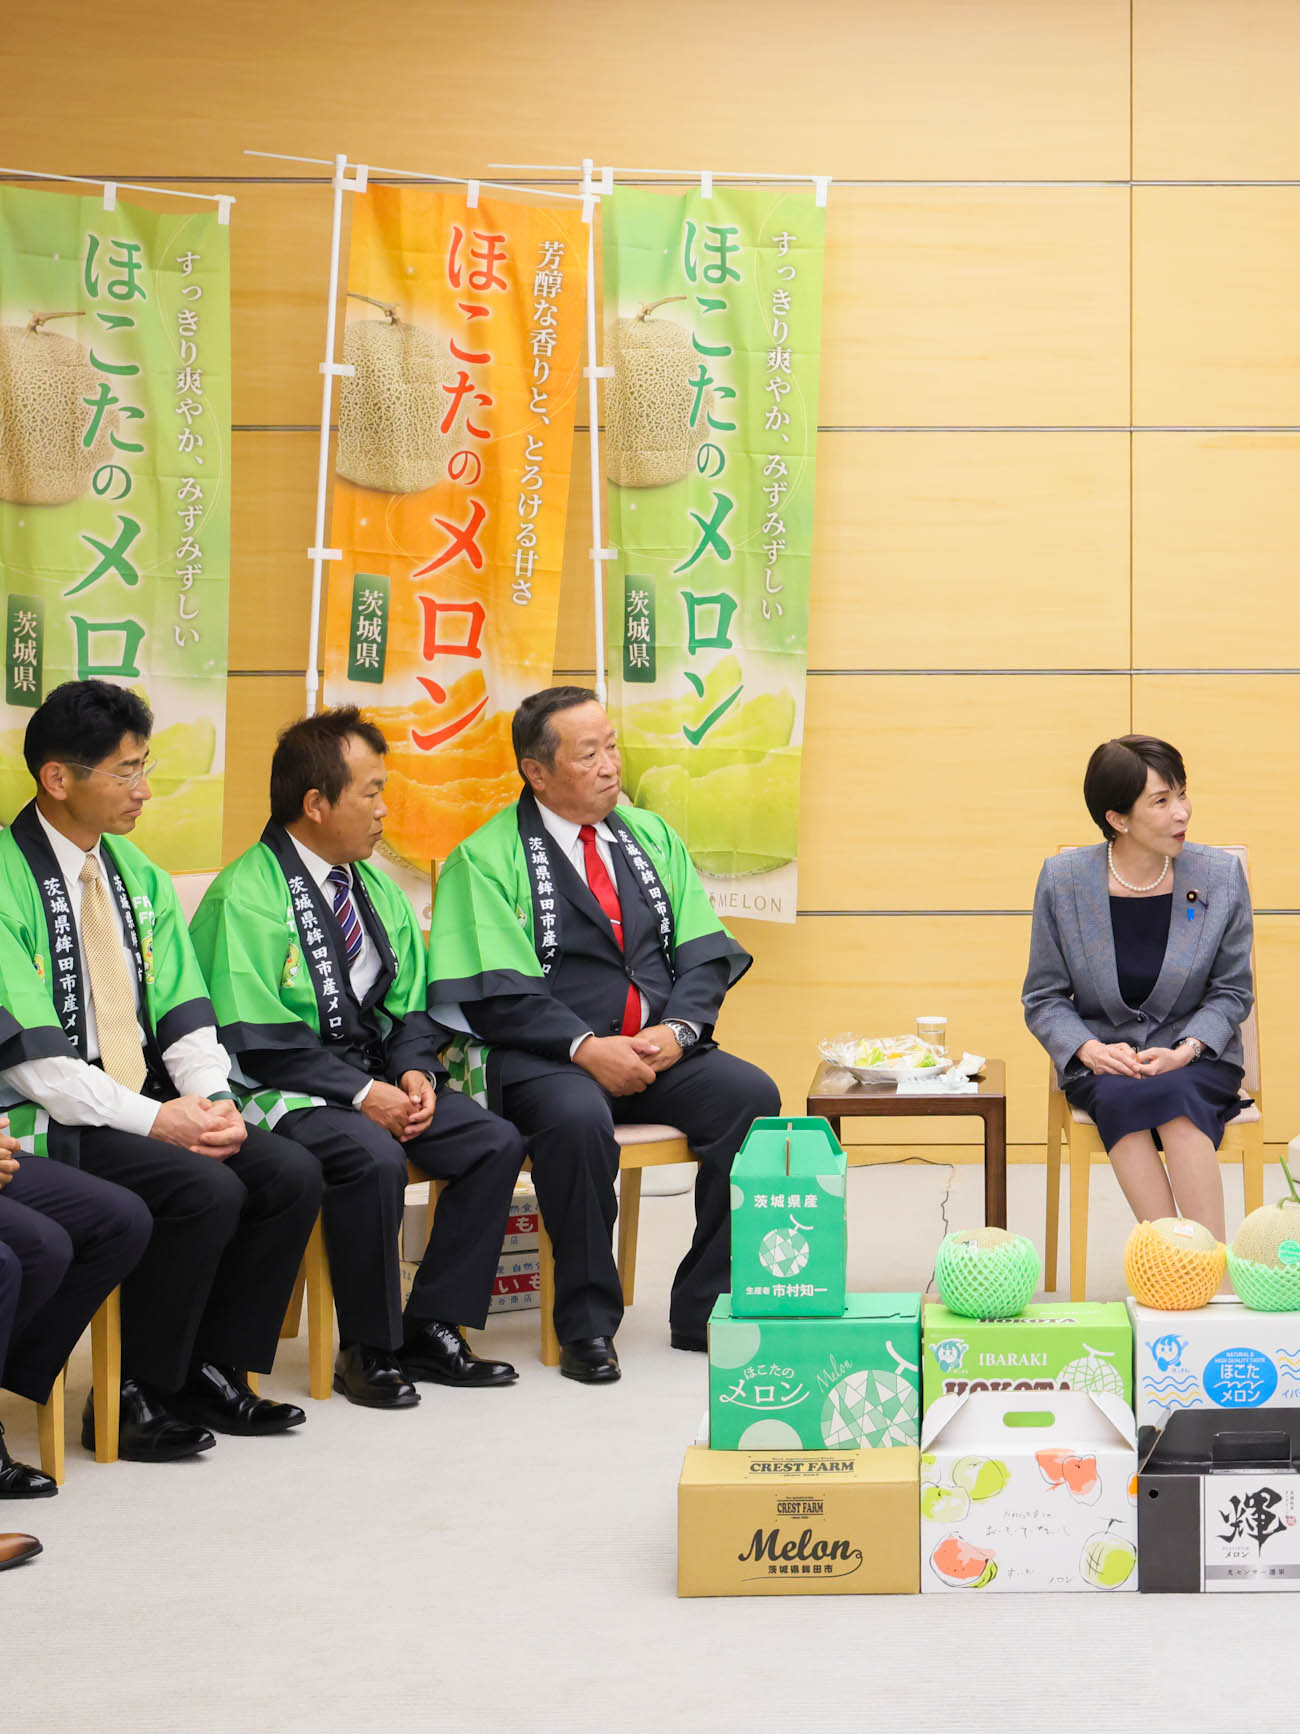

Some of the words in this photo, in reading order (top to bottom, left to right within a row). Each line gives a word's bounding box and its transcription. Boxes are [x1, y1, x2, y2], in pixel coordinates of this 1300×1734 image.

[511, 240, 565, 606] 芳醇な香りと、とろける甘さ
[761, 231, 798, 620] すっきり爽やか、みずみずしい
[174, 251, 204, 647] すっきり爽やか、みずみずしい
[411, 226, 508, 751] ほこたのメロン
[673, 220, 744, 746] ほこたのメロン
[354, 588, 384, 669] 茨城県
[627, 590, 651, 669] 茨城県
[12, 610, 38, 693] 茨城県
[718, 892, 782, 913] MELON
[753, 1194, 818, 1208] 茨城県産
[772, 1283, 828, 1298] 市村知一
[743, 1363, 795, 1381] ほこたの
[979, 1352, 1048, 1367] IBARAKI
[1220, 1363, 1260, 1379] ほこた
[719, 1379, 808, 1408] メロン
[1221, 1389, 1261, 1403] メロン
[750, 1462, 804, 1472] CREST
[808, 1461, 855, 1471] FARM
[776, 1502, 801, 1513] CREST
[802, 1502, 824, 1513] FARM
[1216, 1486, 1288, 1558] 輝
[738, 1528, 862, 1562] Melon
[1225, 1551, 1249, 1559] メロン
